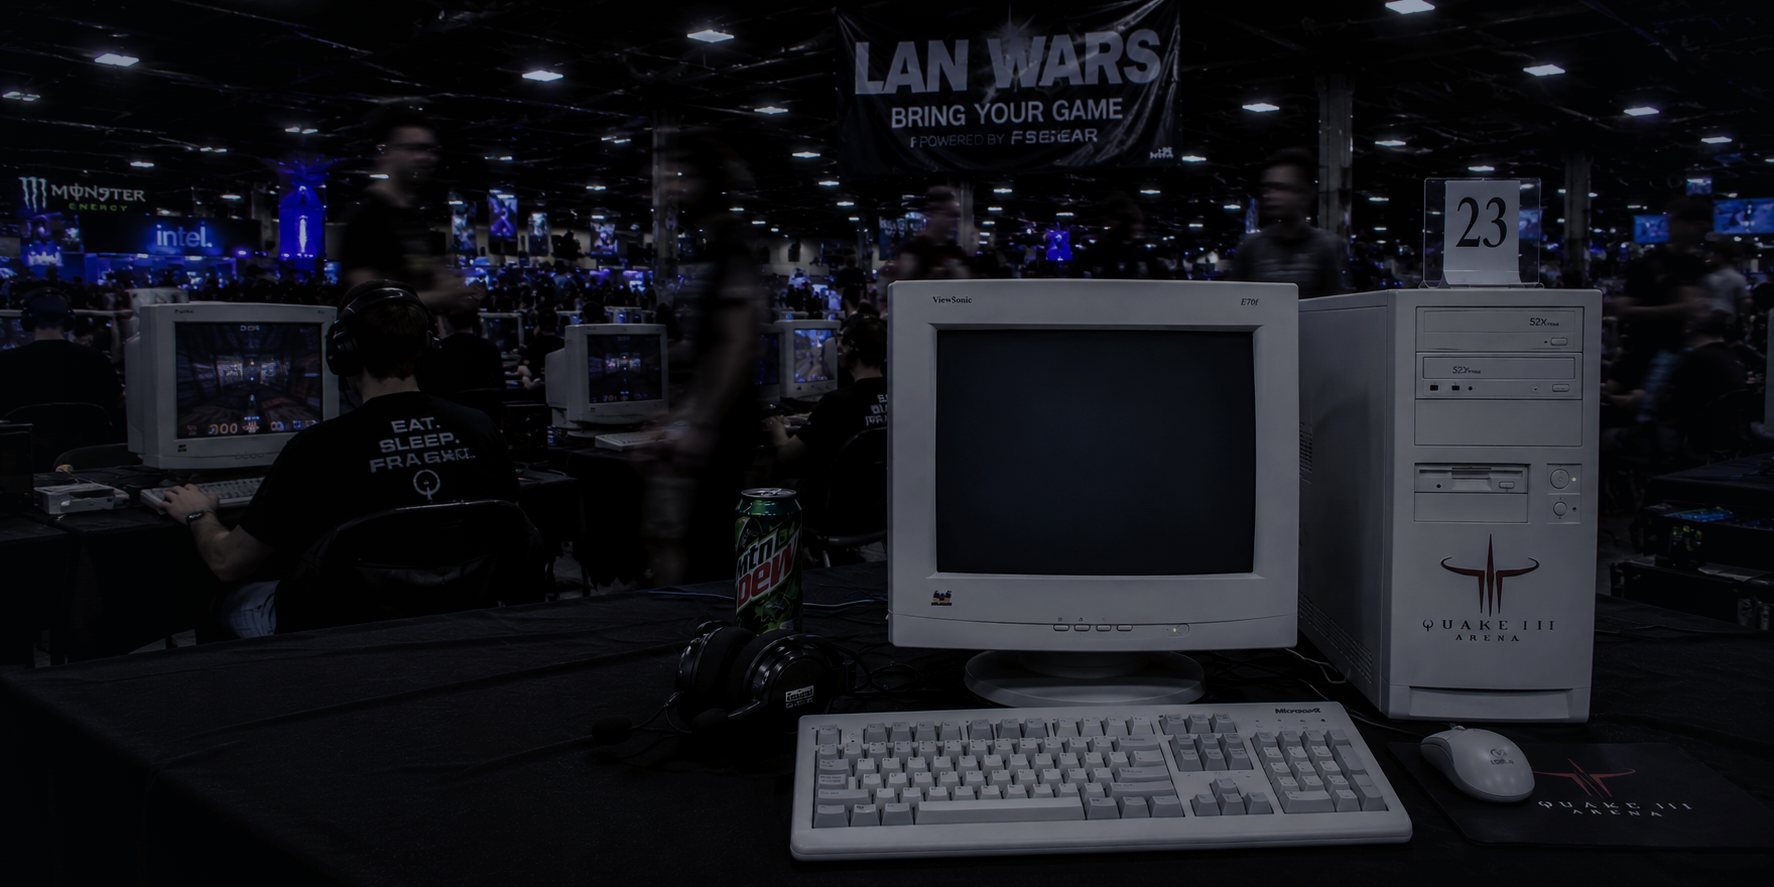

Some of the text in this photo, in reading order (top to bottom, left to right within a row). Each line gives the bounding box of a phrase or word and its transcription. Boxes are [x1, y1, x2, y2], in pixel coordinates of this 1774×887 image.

[855, 28, 1161, 95] LAN WARS
[891, 98, 1124, 128] BRING YOUR GAME
[920, 134, 984, 148] POWERED
[987, 133, 1006, 146] BY
[51, 182, 147, 202] MONSTER
[68, 202, 128, 212] ENERGY
[1456, 197, 1507, 248] 23
[932, 295, 972, 304] ViewSonic
[390, 416, 440, 433] EAT.
[378, 432, 460, 453] SLEEP.
[1422, 619, 1554, 631] QUAKE III
